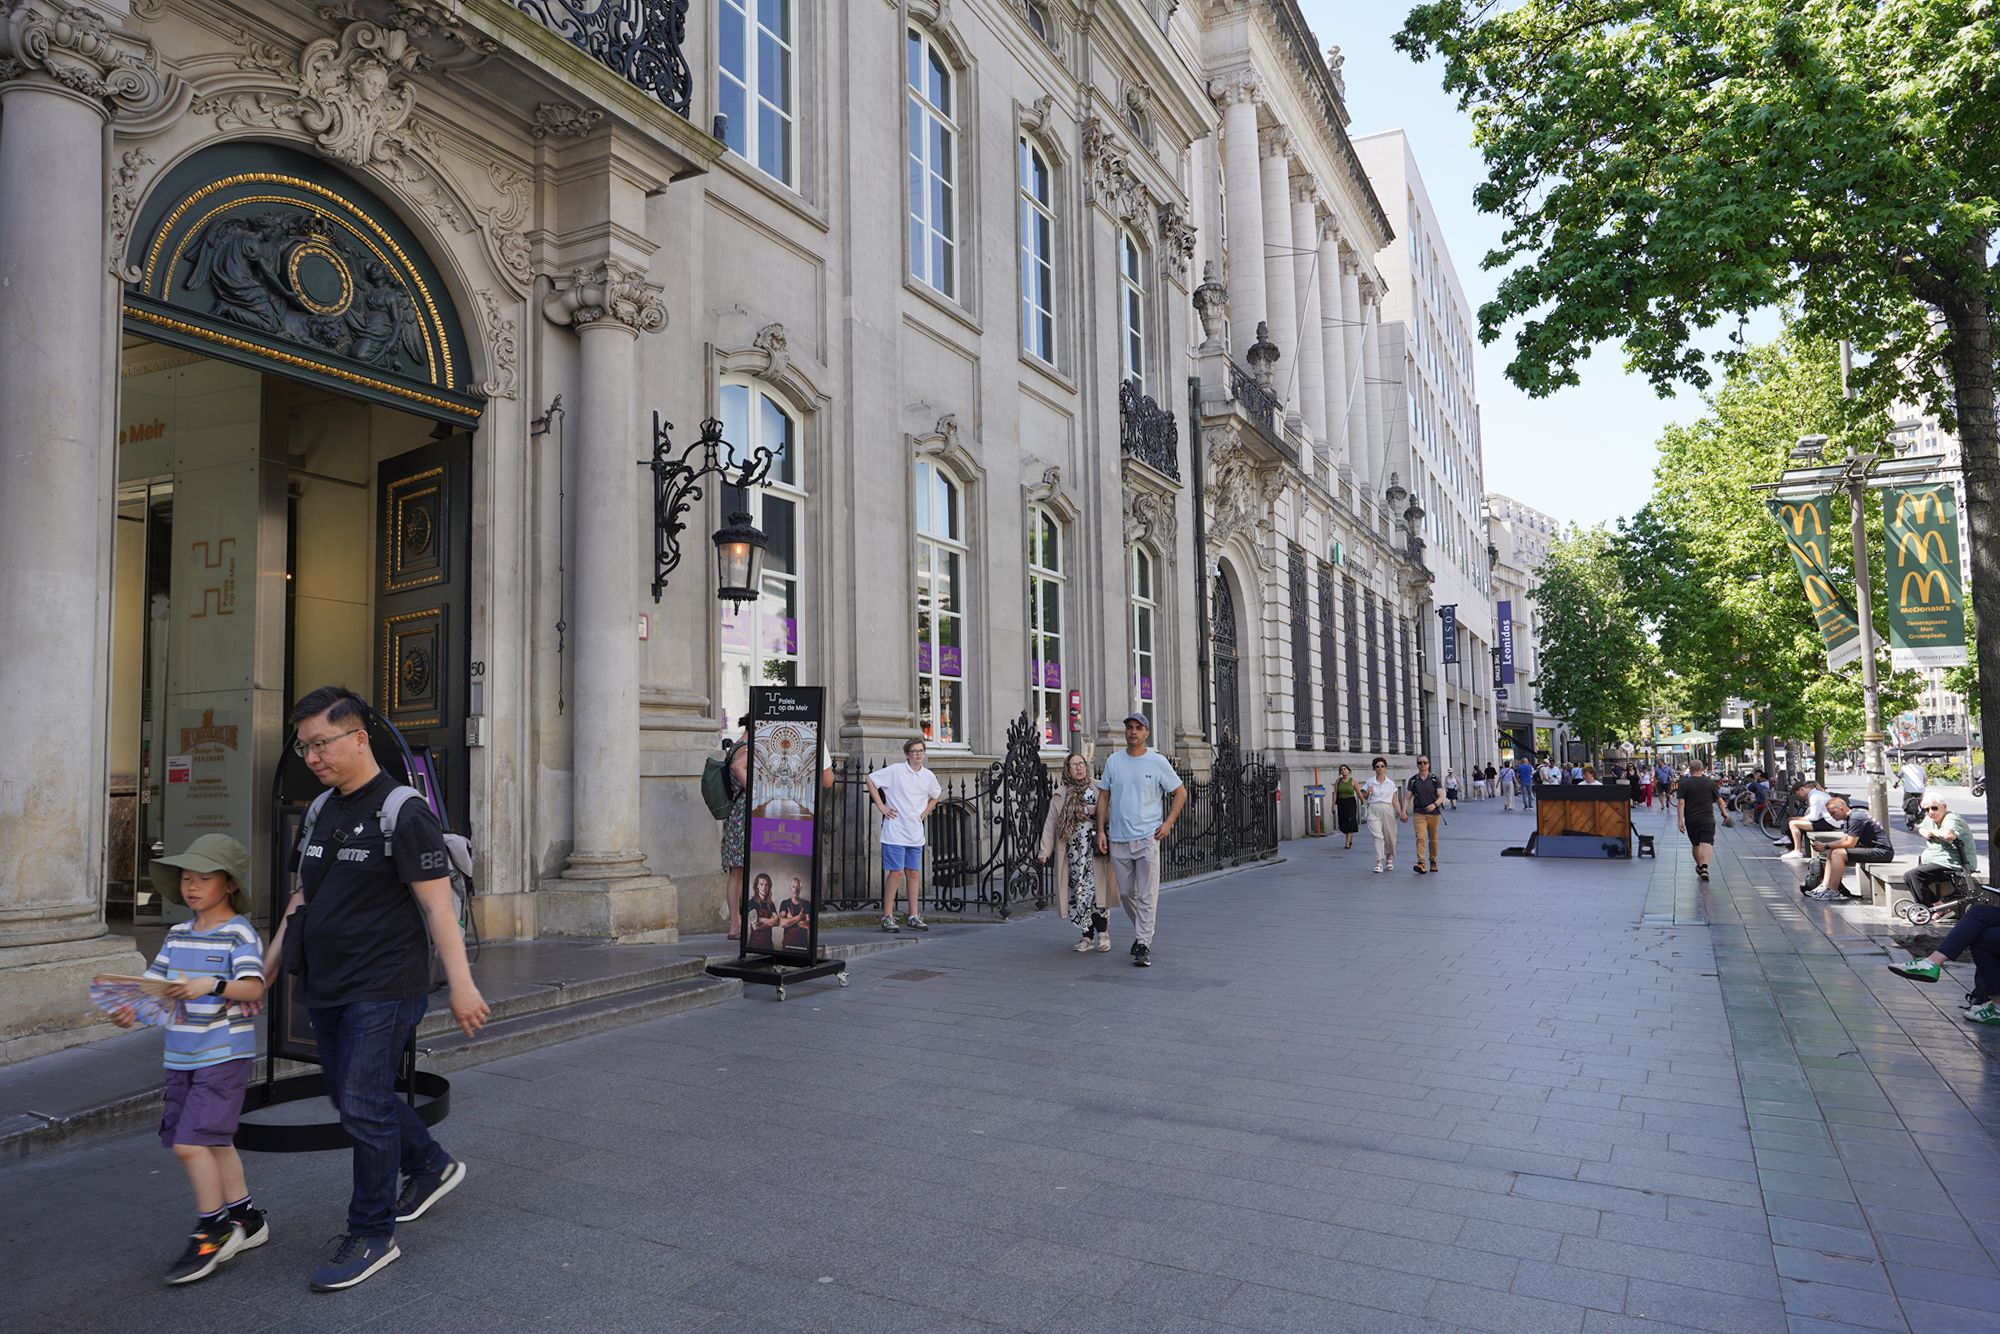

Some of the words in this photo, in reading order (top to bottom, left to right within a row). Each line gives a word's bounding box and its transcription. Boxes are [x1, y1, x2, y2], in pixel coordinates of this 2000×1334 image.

[129, 421, 166, 443] Meir
[1900, 605, 1951, 614] McDonald's
[1444, 606, 1454, 660] COSTES
[1501, 619, 1512, 665] Leonidas
[471, 661, 485, 677] 50
[420, 850, 445, 870] 82
